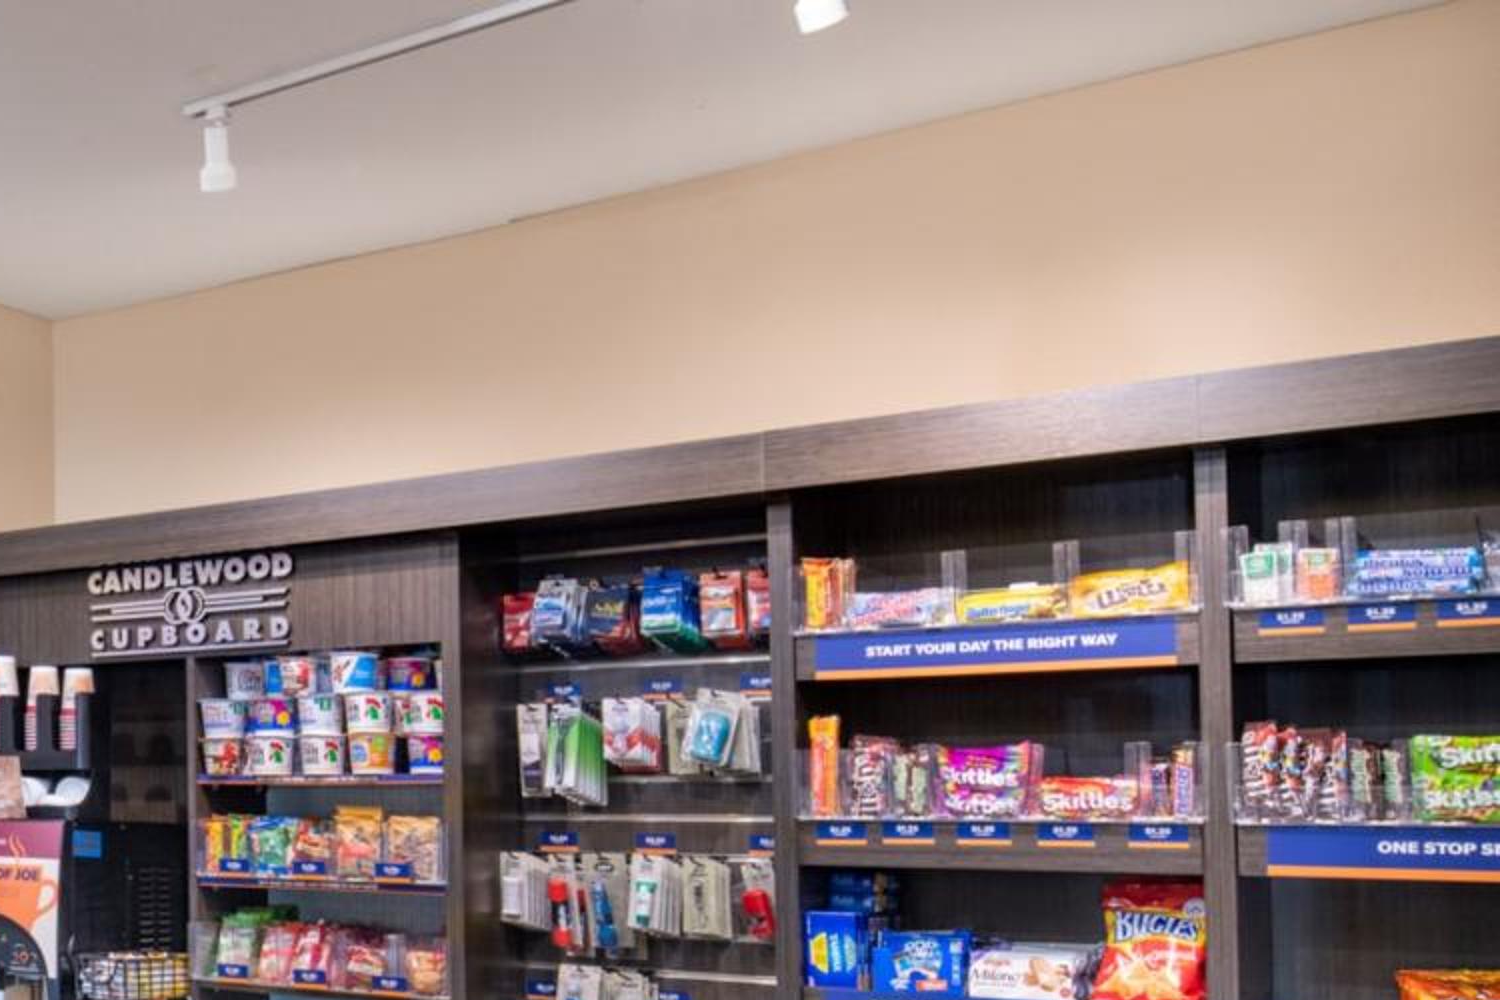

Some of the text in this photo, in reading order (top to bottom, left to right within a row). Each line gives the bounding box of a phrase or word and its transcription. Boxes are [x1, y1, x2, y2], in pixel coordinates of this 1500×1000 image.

[87, 552, 293, 595] CANDLEWOOD
[90, 615, 290, 650] CUPBOARD
[866, 633, 1118, 658] START YOUR DAY THE RIGHT WAY
[1041, 788, 1134, 812] Skittles
[1377, 840, 1419, 855] ONE
[1423, 842, 1477, 856] STOP
